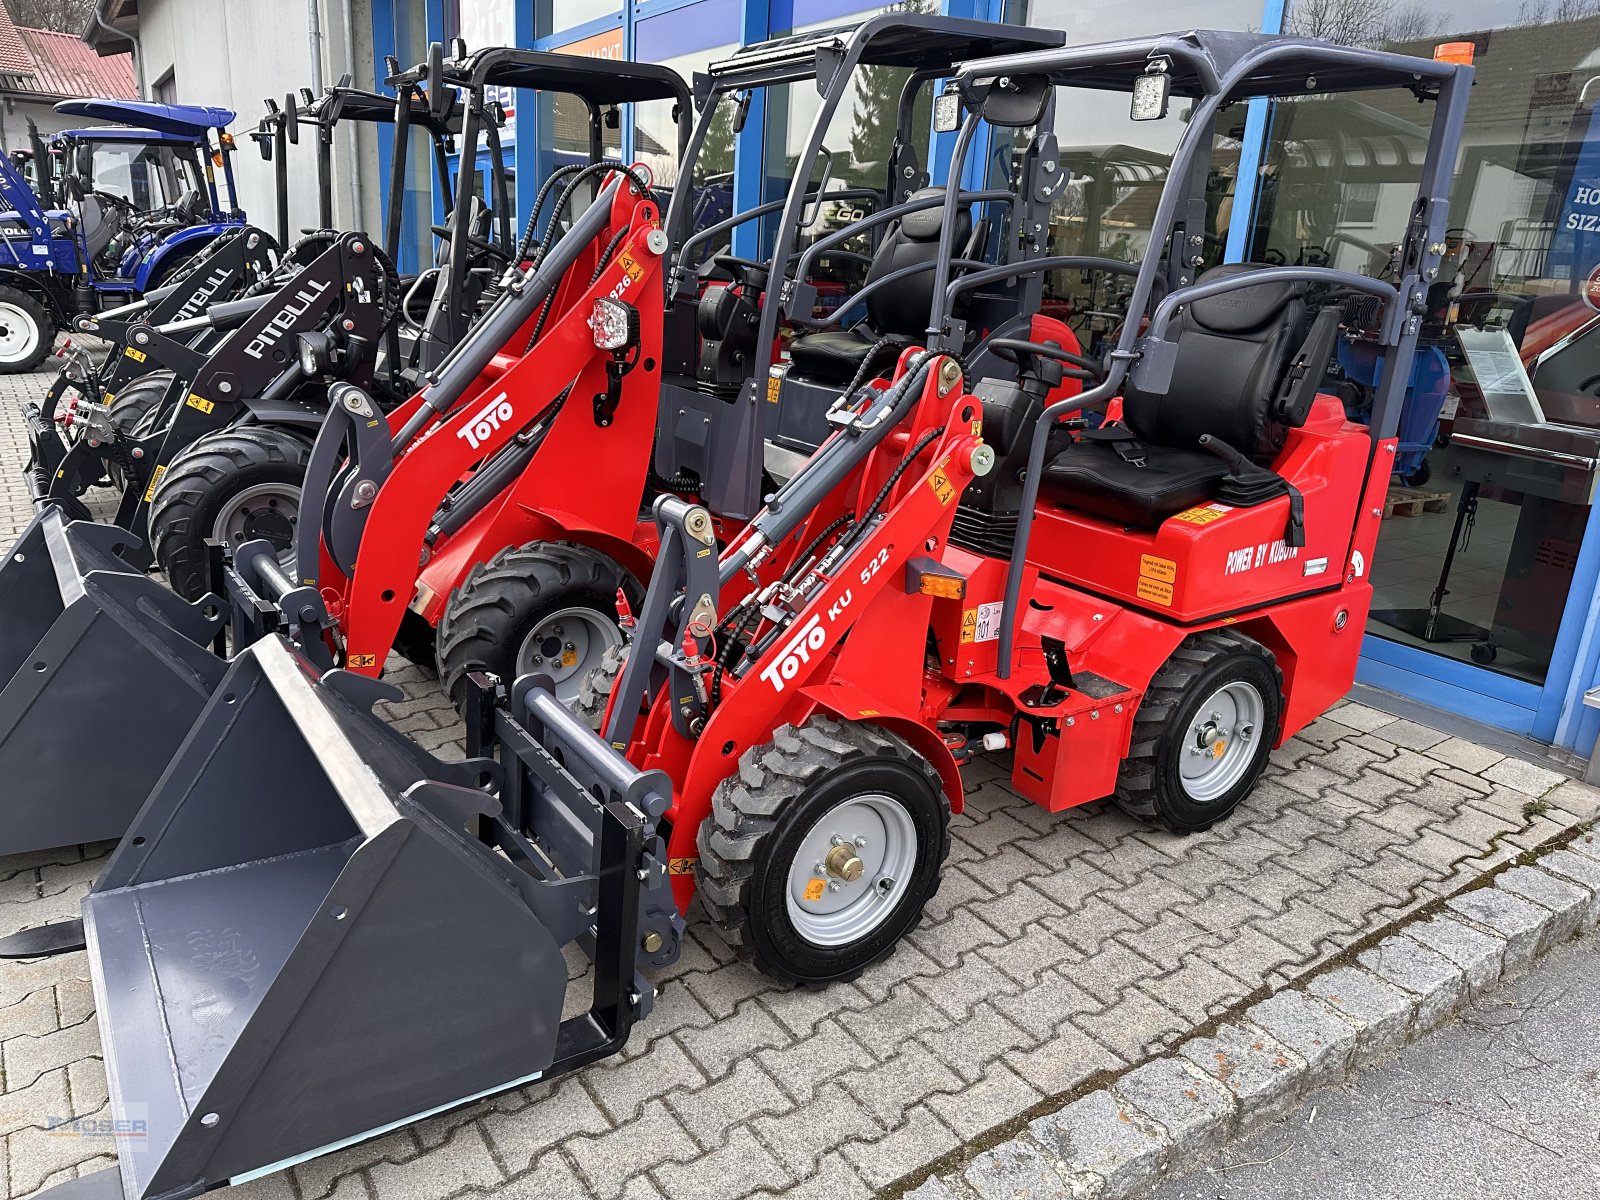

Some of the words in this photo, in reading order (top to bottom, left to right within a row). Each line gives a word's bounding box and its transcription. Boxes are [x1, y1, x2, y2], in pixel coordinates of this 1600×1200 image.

[1566, 212, 1600, 233] SIZ
[168, 267, 234, 325] PITBULL
[243, 279, 332, 360] PITBULL
[456, 391, 513, 450] TOYO
[1225, 546, 1254, 576] POWER
[1254, 542, 1269, 569] BY
[759, 612, 826, 693] TOYO
[827, 588, 853, 623] KU
[860, 547, 889, 585] 522
[977, 620, 990, 638] 101
